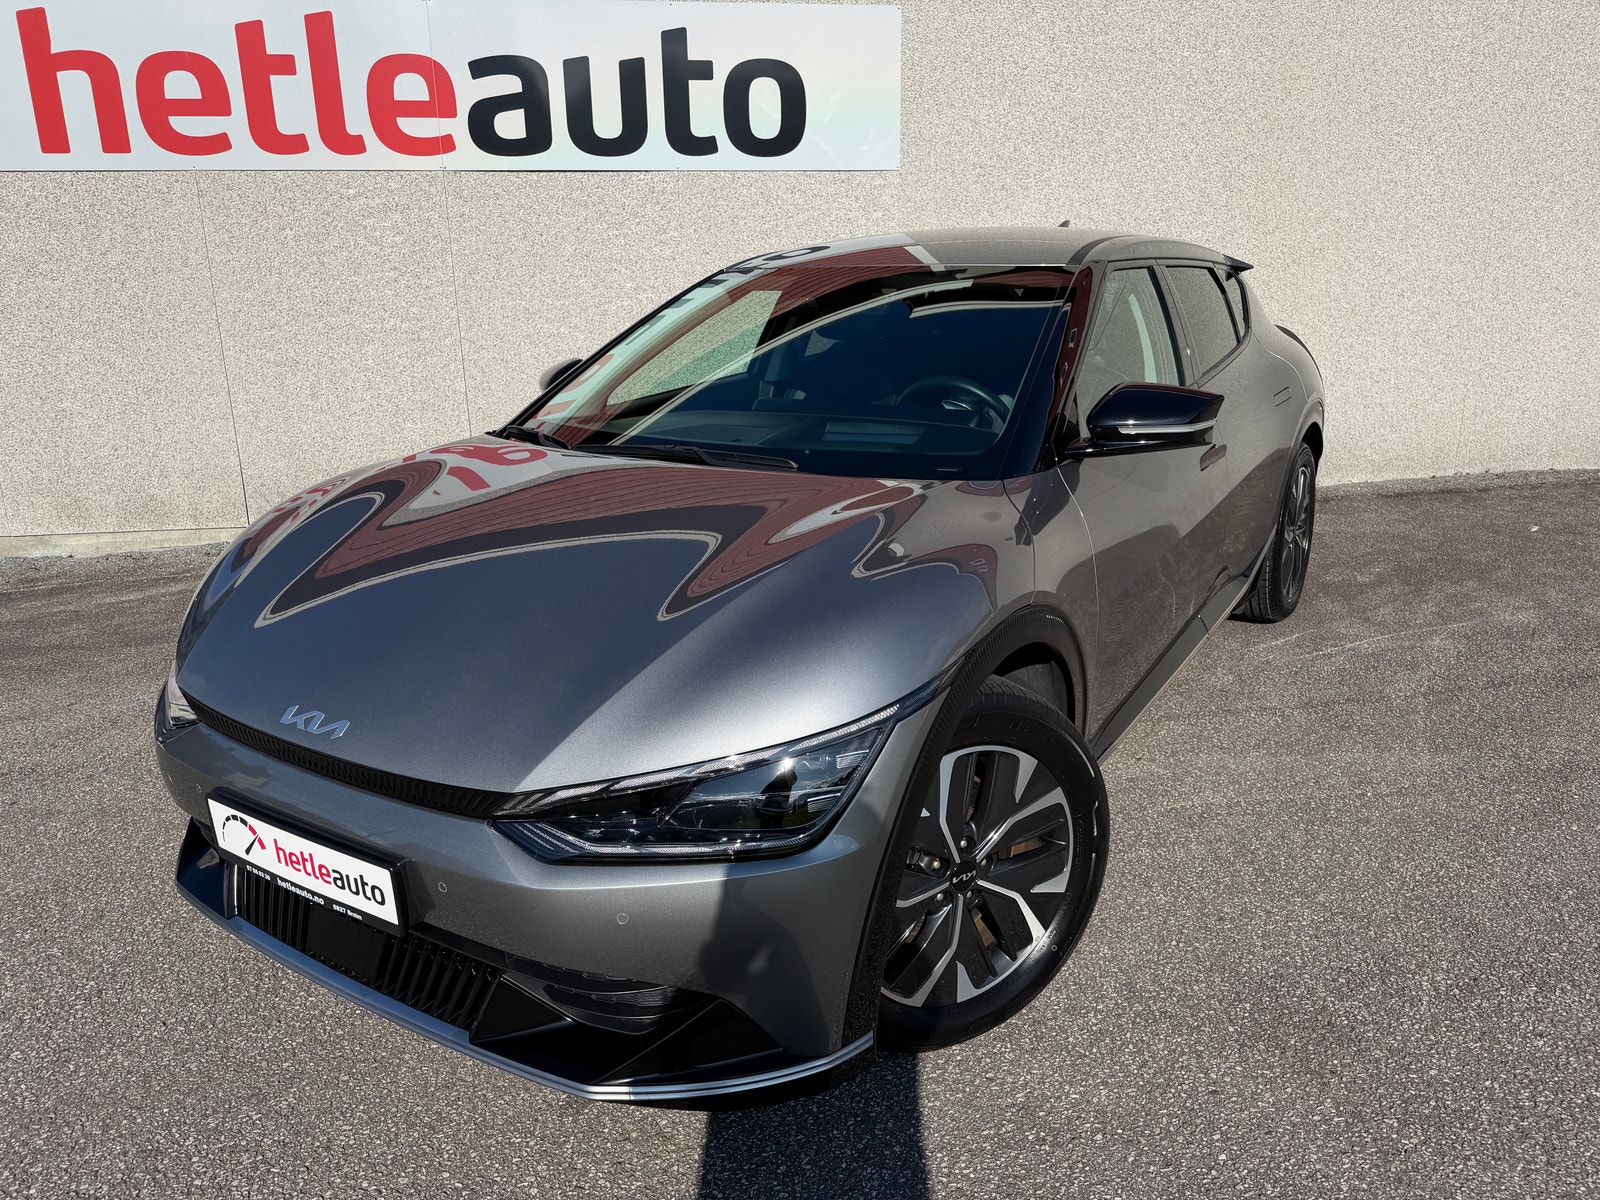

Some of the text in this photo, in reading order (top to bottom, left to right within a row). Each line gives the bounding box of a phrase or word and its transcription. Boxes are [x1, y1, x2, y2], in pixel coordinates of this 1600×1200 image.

[17, 8, 806, 157] hetleauto
[280, 705, 350, 739] KIA
[273, 838, 386, 906] hetleauto
[277, 878, 325, 904] hetleauto.no
